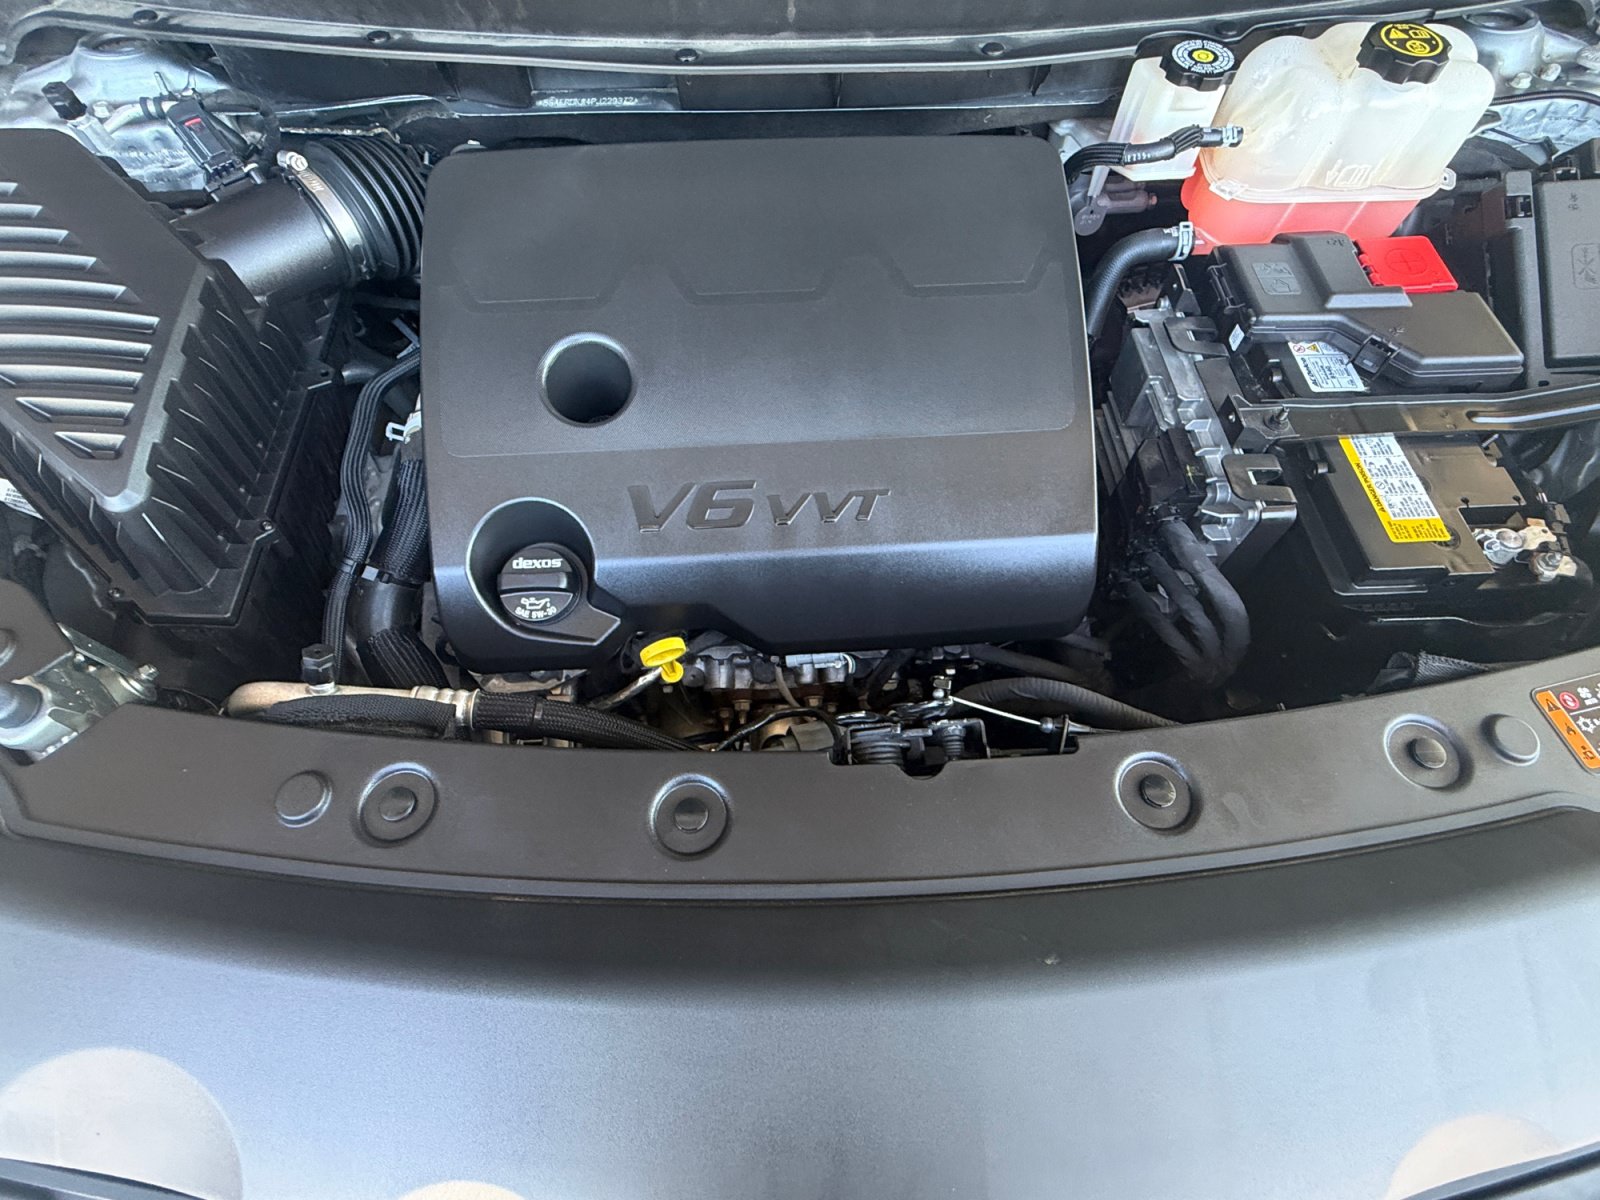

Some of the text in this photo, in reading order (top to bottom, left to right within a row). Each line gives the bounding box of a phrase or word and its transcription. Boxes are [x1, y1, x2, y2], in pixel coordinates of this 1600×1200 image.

[1366, 483, 1382, 507] DANGER
[627, 480, 891, 533] V6 VVT
[512, 557, 563, 569] dexos
[515, 605, 557, 619] SAE 5W-30
